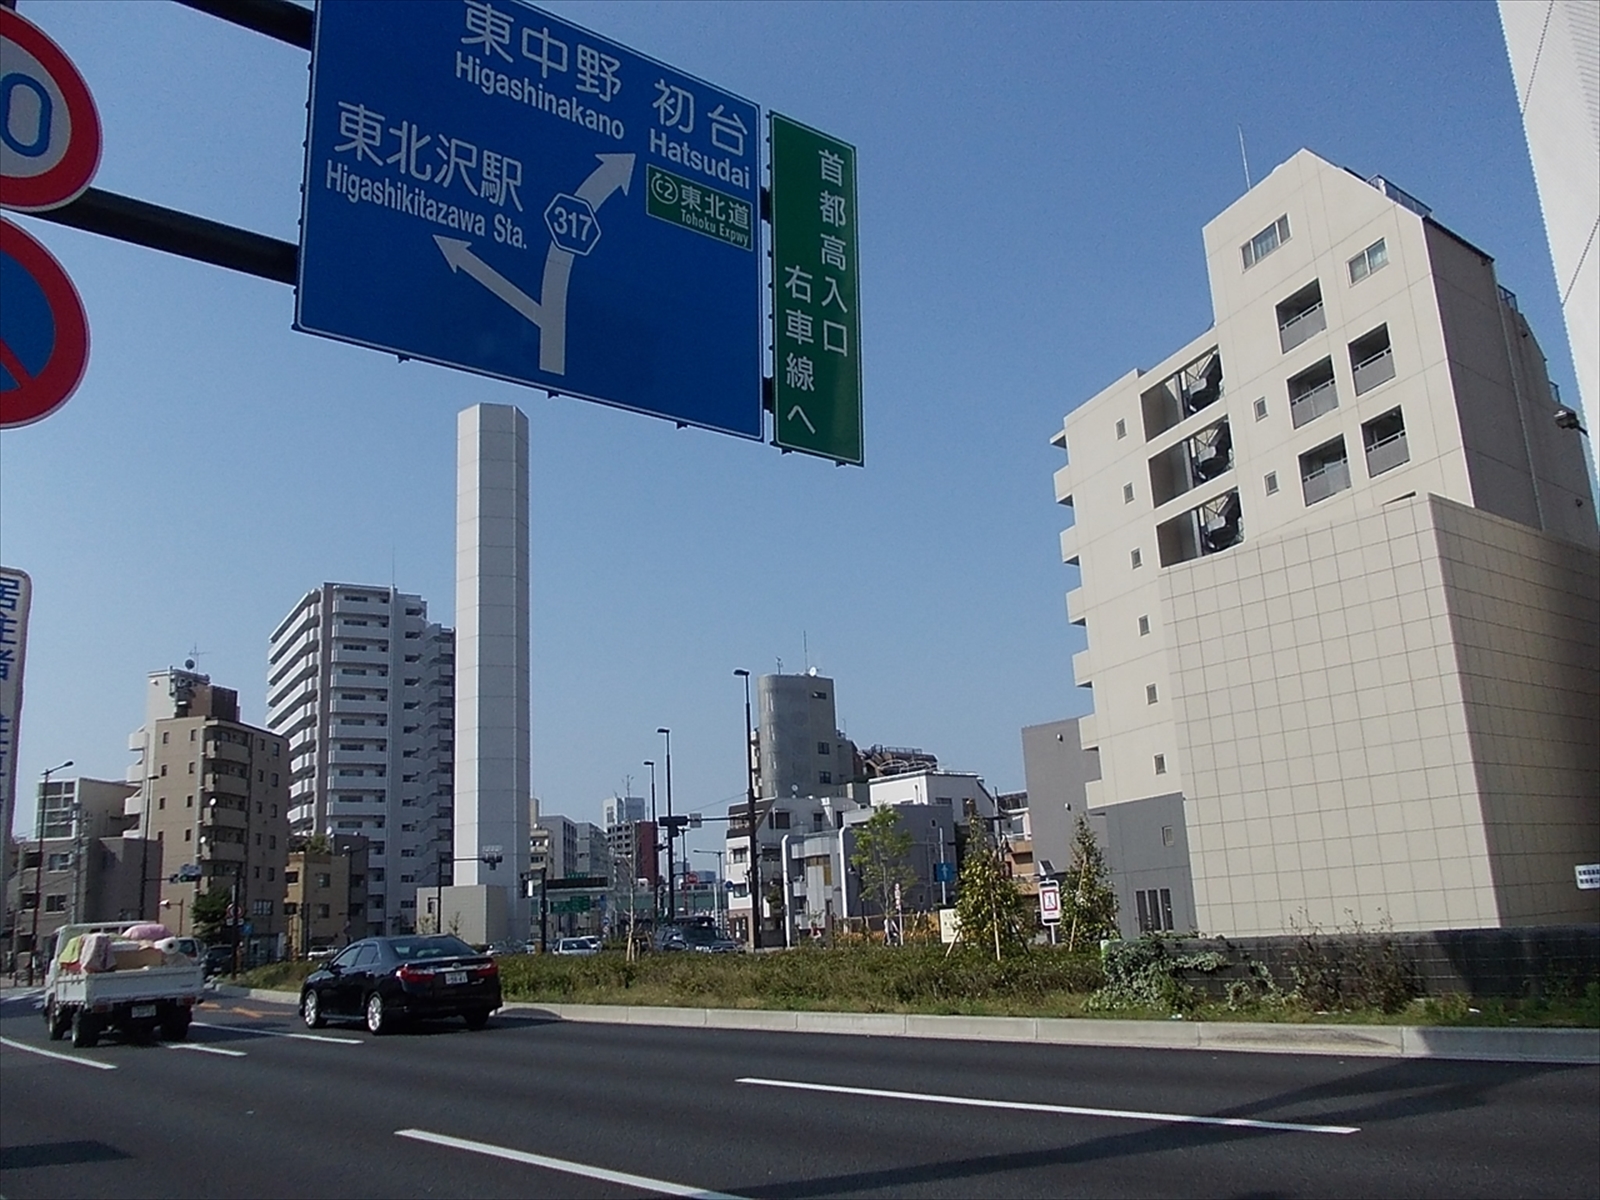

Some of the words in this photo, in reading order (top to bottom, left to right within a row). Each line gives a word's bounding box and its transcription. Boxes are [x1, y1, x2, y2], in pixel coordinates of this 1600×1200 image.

[455, 50, 625, 140] Higashinakano
[460, 0, 622, 103] 東中野
[333, 100, 524, 213] 東北沢駅
[649, 127, 751, 190] Hatsudai
[651, 78, 749, 157] 初台
[325, 158, 486, 237] Higashikitazawa
[493, 212, 528, 250] Sta.
[552, 206, 593, 243] 317
[680, 184, 750, 231] 東北道
[680, 208, 717, 234] Tohoku
[718, 222, 750, 248] Expwy
[818, 148, 849, 358] 首都高入口
[784, 264, 817, 435] 右車線へ
